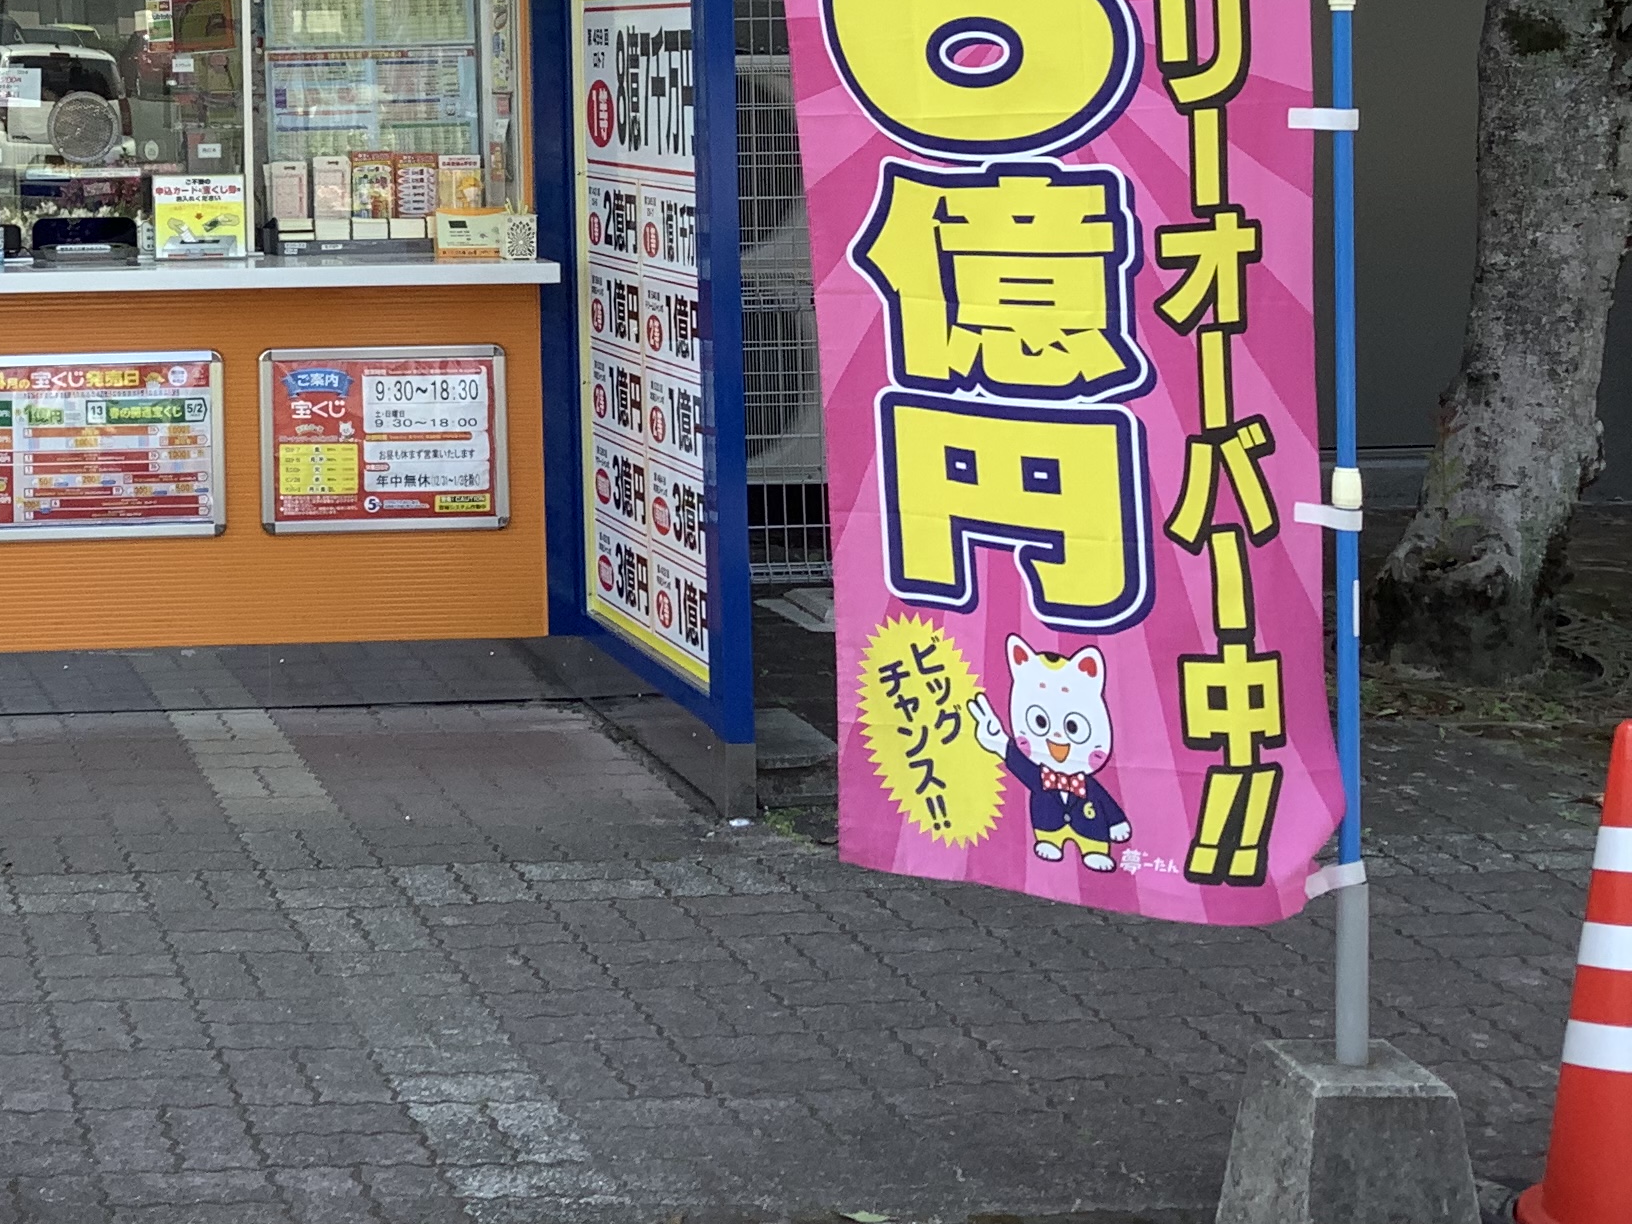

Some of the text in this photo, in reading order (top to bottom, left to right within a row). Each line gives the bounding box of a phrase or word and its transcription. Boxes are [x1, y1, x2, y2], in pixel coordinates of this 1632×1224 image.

[297, 374, 339, 388] ご案内
[291, 401, 346, 419] 宝くじ
[909, 636, 962, 744] ビッグ
[878, 659, 952, 831] チャンス!!
[1083, 801, 1096, 819] 6
